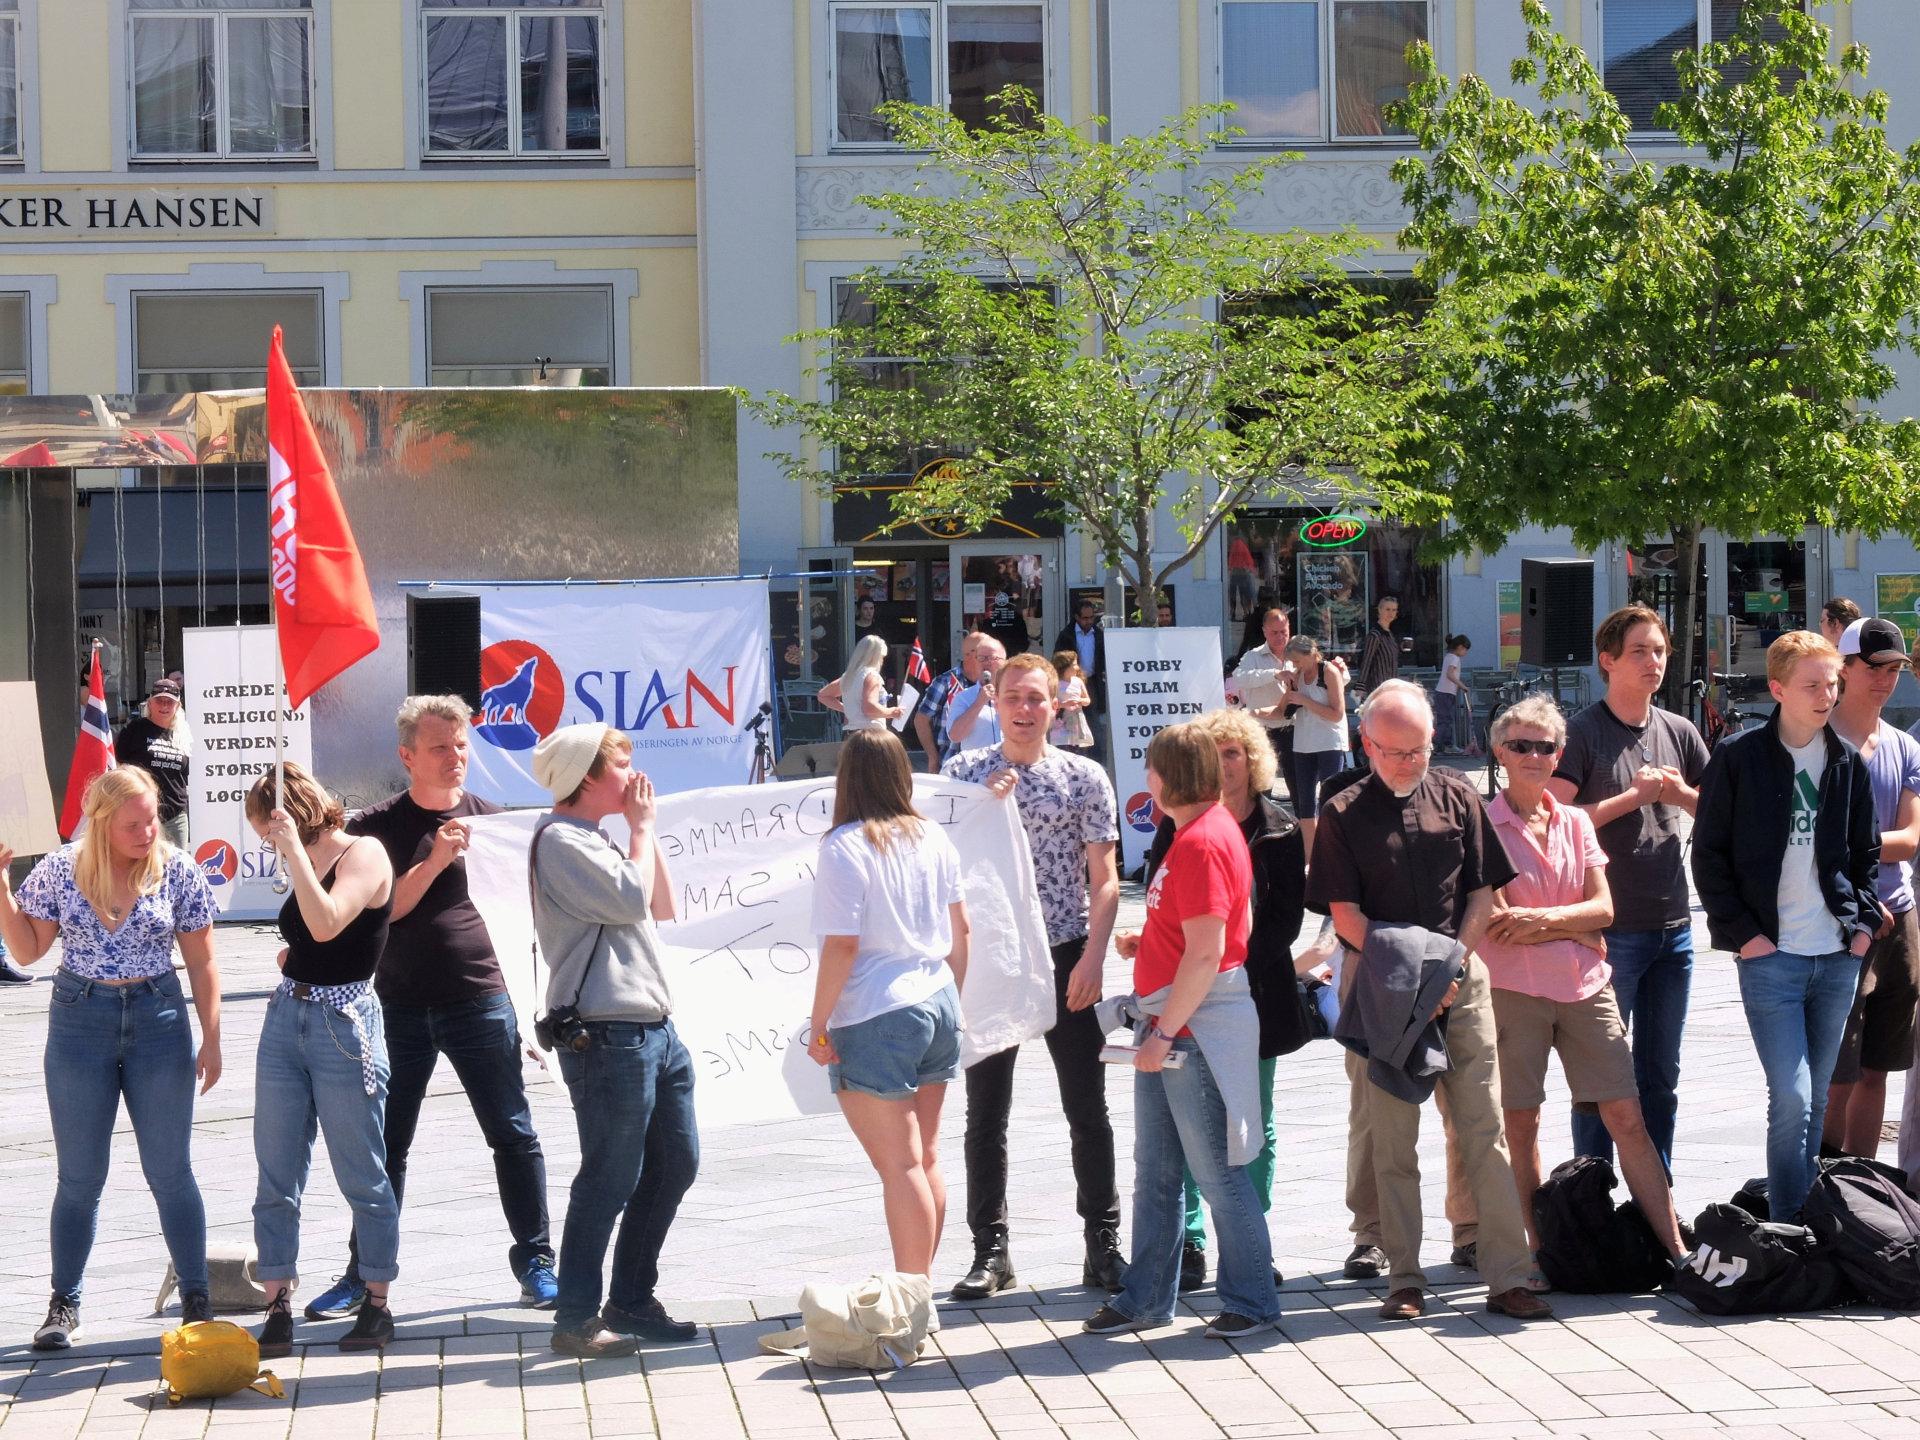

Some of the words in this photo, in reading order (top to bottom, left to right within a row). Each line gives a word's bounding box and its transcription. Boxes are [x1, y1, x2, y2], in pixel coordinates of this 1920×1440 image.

[86, 197, 263, 228] HANSEN
[1308, 522, 1357, 538] OPEN
[1305, 563, 1340, 573] Chicken
[1305, 573, 1332, 581] Bacon
[1305, 581, 1343, 590] Avocado
[1122, 660, 1182, 672] FORBY
[1124, 682, 1179, 694] ISLAM
[573, 665, 739, 731] SIAN
[1126, 703, 1164, 716] FØR
[1167, 703, 1203, 715] DEN
[204, 736, 289, 751] VERDENS
[691, 736, 703, 747] AV
[706, 734, 743, 746] NORGE
[205, 763, 275, 777] STØRST
